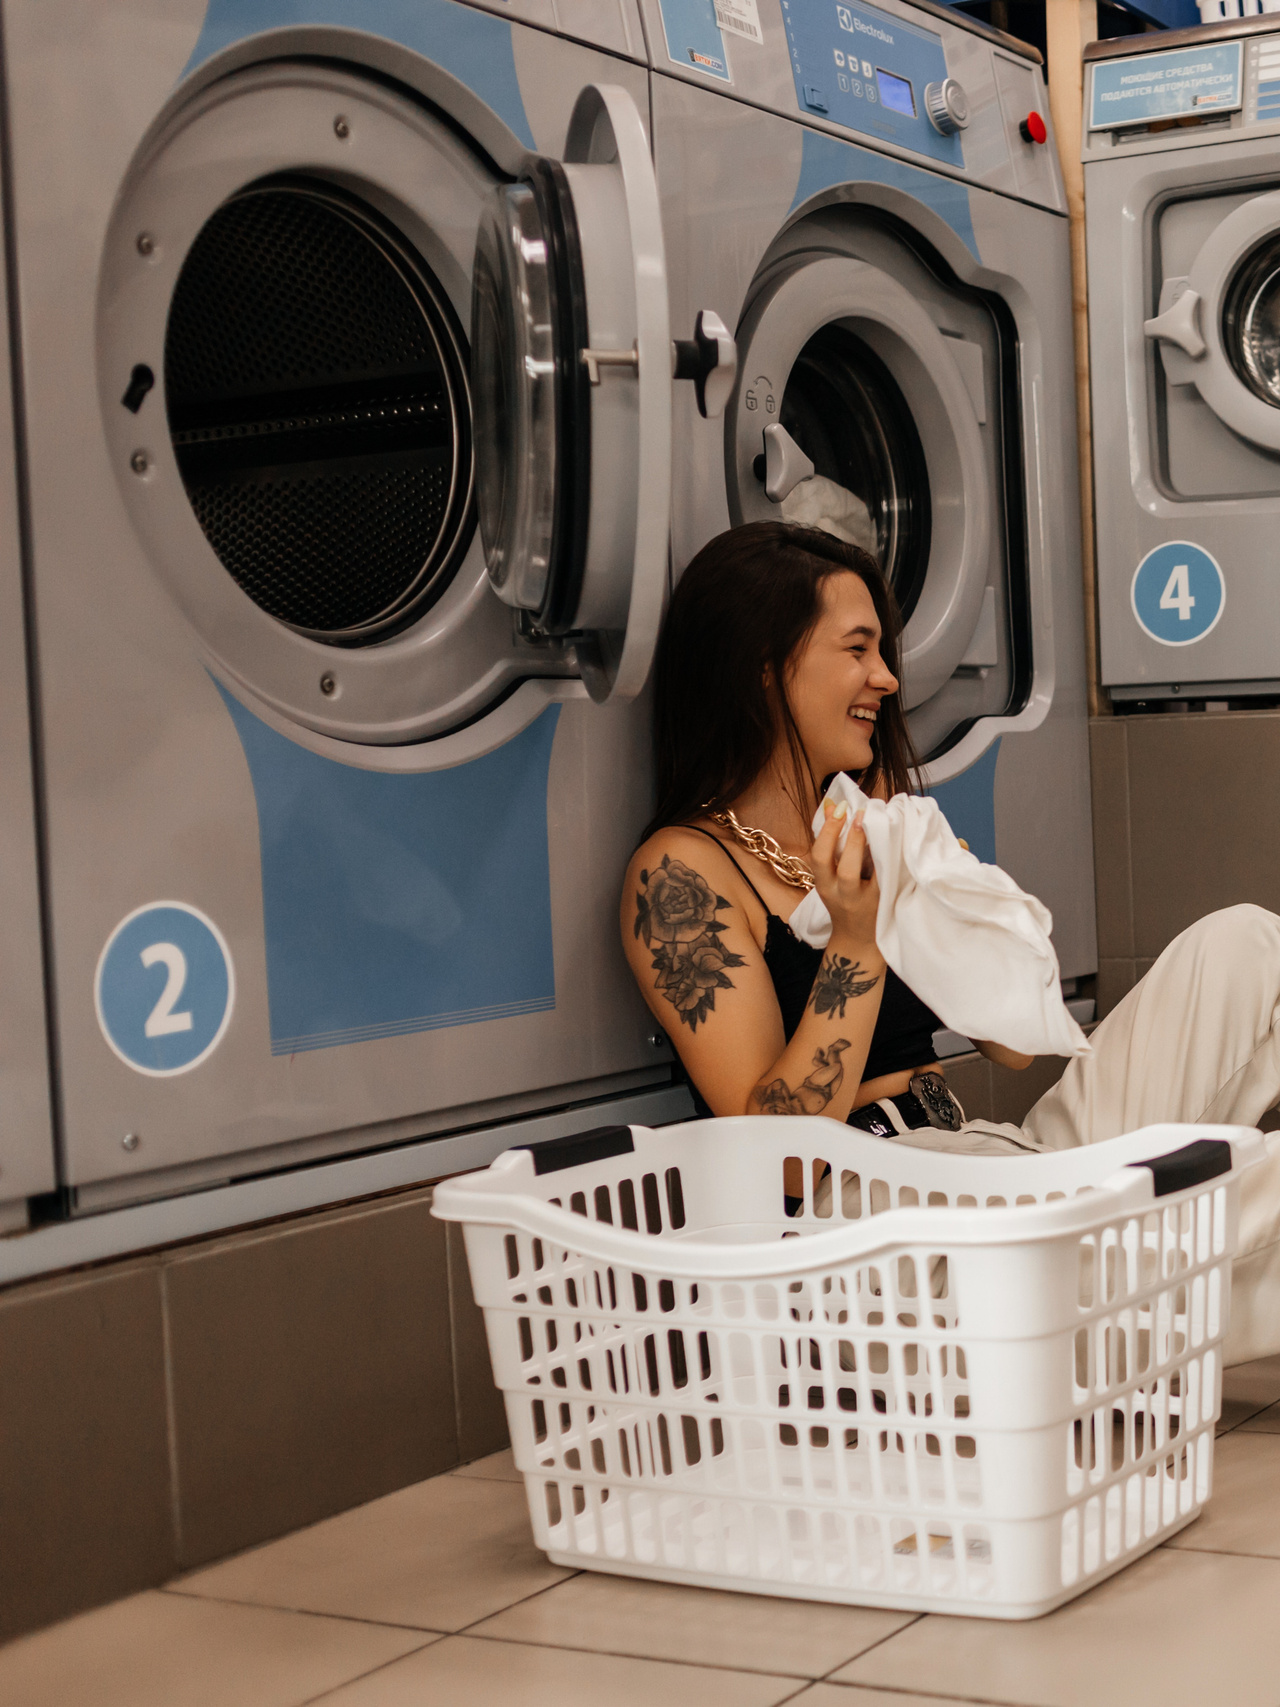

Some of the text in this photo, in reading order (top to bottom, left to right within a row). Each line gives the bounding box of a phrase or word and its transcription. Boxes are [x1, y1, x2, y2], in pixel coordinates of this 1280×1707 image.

[853, 17, 895, 45] Electrolux
[1101, 73, 1233, 102] ПОДАЮТСЯ АВТОМАТИЧЕСКИ
[1120, 62, 1214, 85] МОЮЩИЕ СРЕДСТВА
[854, 83, 861, 94] 2
[868, 87, 875, 100] 3
[1159, 564, 1195, 621] 4
[139, 942, 193, 1038] 2
